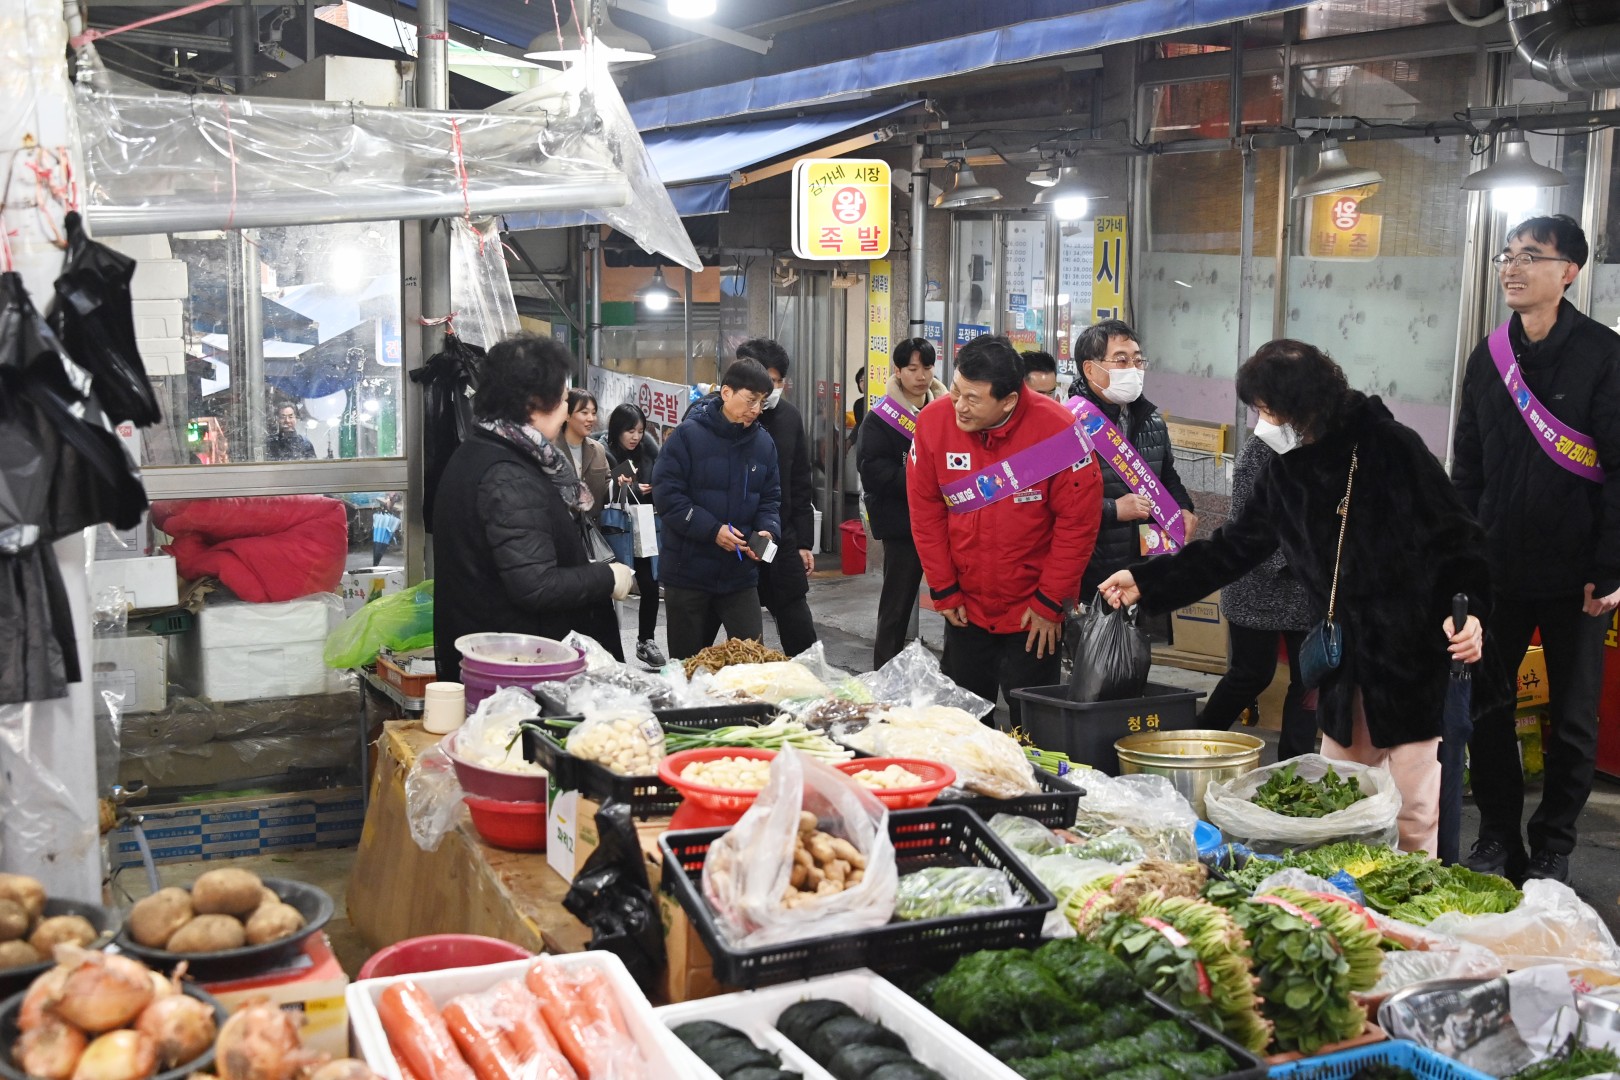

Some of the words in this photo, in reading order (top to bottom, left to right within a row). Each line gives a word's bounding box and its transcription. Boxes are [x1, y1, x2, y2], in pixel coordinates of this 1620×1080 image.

[808, 164, 846, 197] 김가네
[855, 167, 881, 182] 시장
[836, 191, 863, 221] 왕
[1096, 218, 1123, 233] 김가네
[1529, 409, 1557, 442] 행복한
[1105, 427, 1134, 462] 시장에서
[1131, 458, 1160, 497] 장보GO!
[1111, 453, 1140, 487] 전통시장
[1522, 669, 1541, 690] 부추
[1127, 713, 1160, 732] 청하
